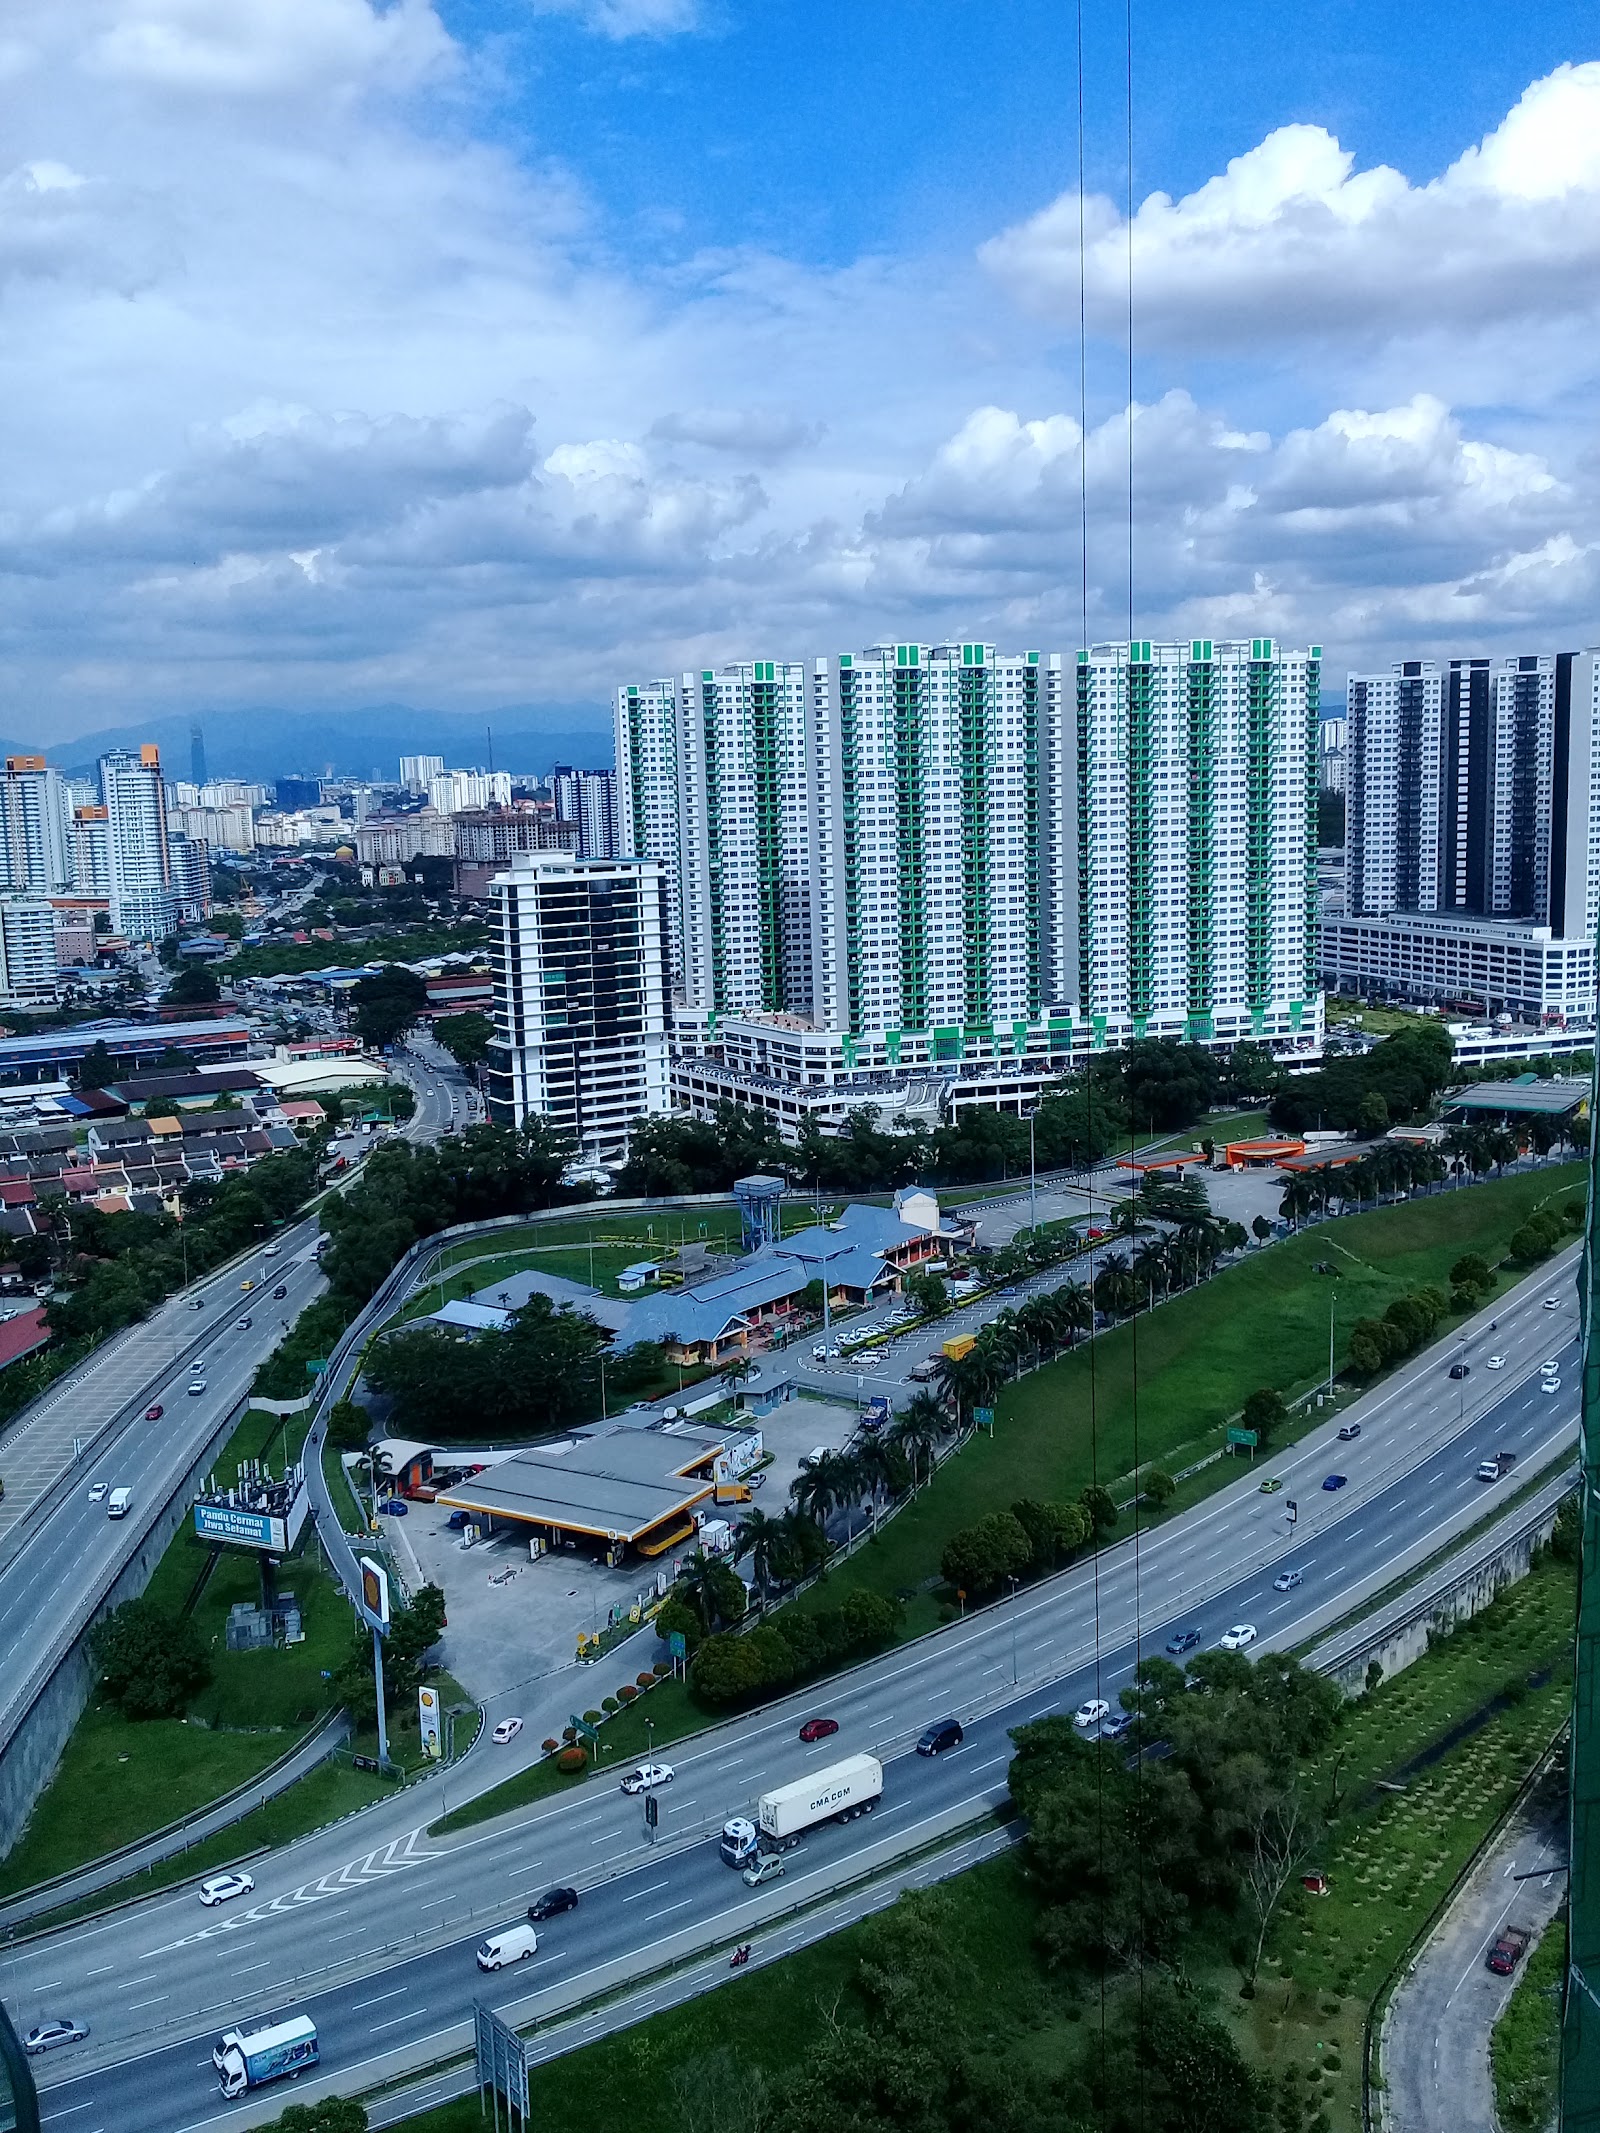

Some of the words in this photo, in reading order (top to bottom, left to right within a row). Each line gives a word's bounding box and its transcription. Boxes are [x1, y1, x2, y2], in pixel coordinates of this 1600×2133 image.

[201, 1509, 229, 1522] Pandu
[230, 1513, 264, 1528] Cermat
[204, 1519, 224, 1531] Jiwa
[225, 1523, 262, 1538] Selamat
[810, 1796, 830, 1810] CMA
[831, 1786, 851, 1801] CGM
